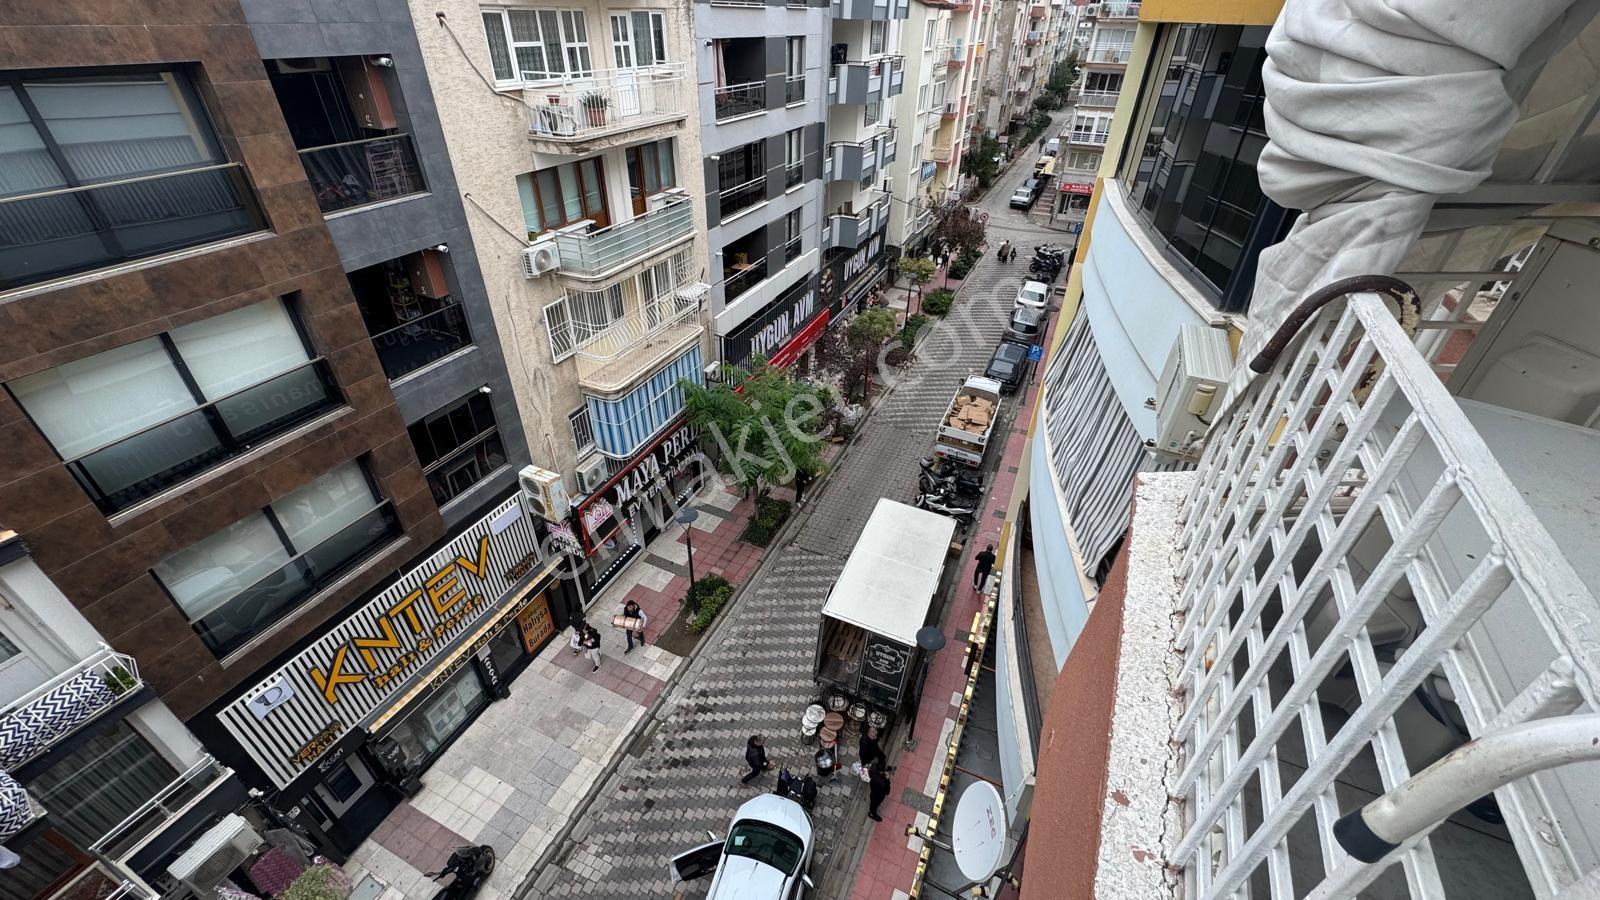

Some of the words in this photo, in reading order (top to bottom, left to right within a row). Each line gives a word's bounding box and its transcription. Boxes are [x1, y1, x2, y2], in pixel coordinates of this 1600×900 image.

[751, 311, 789, 356] UYGUN
[793, 290, 814, 327] AVM
[613, 452, 661, 509] MAYA
[661, 421, 701, 466] PERD
[628, 500, 642, 518] EV
[308, 533, 490, 706] KNTEV
[418, 637, 434, 653] &
[433, 594, 483, 639] Perde
[528, 623, 552, 648] Burada
[430, 649, 472, 690] KNTEV
